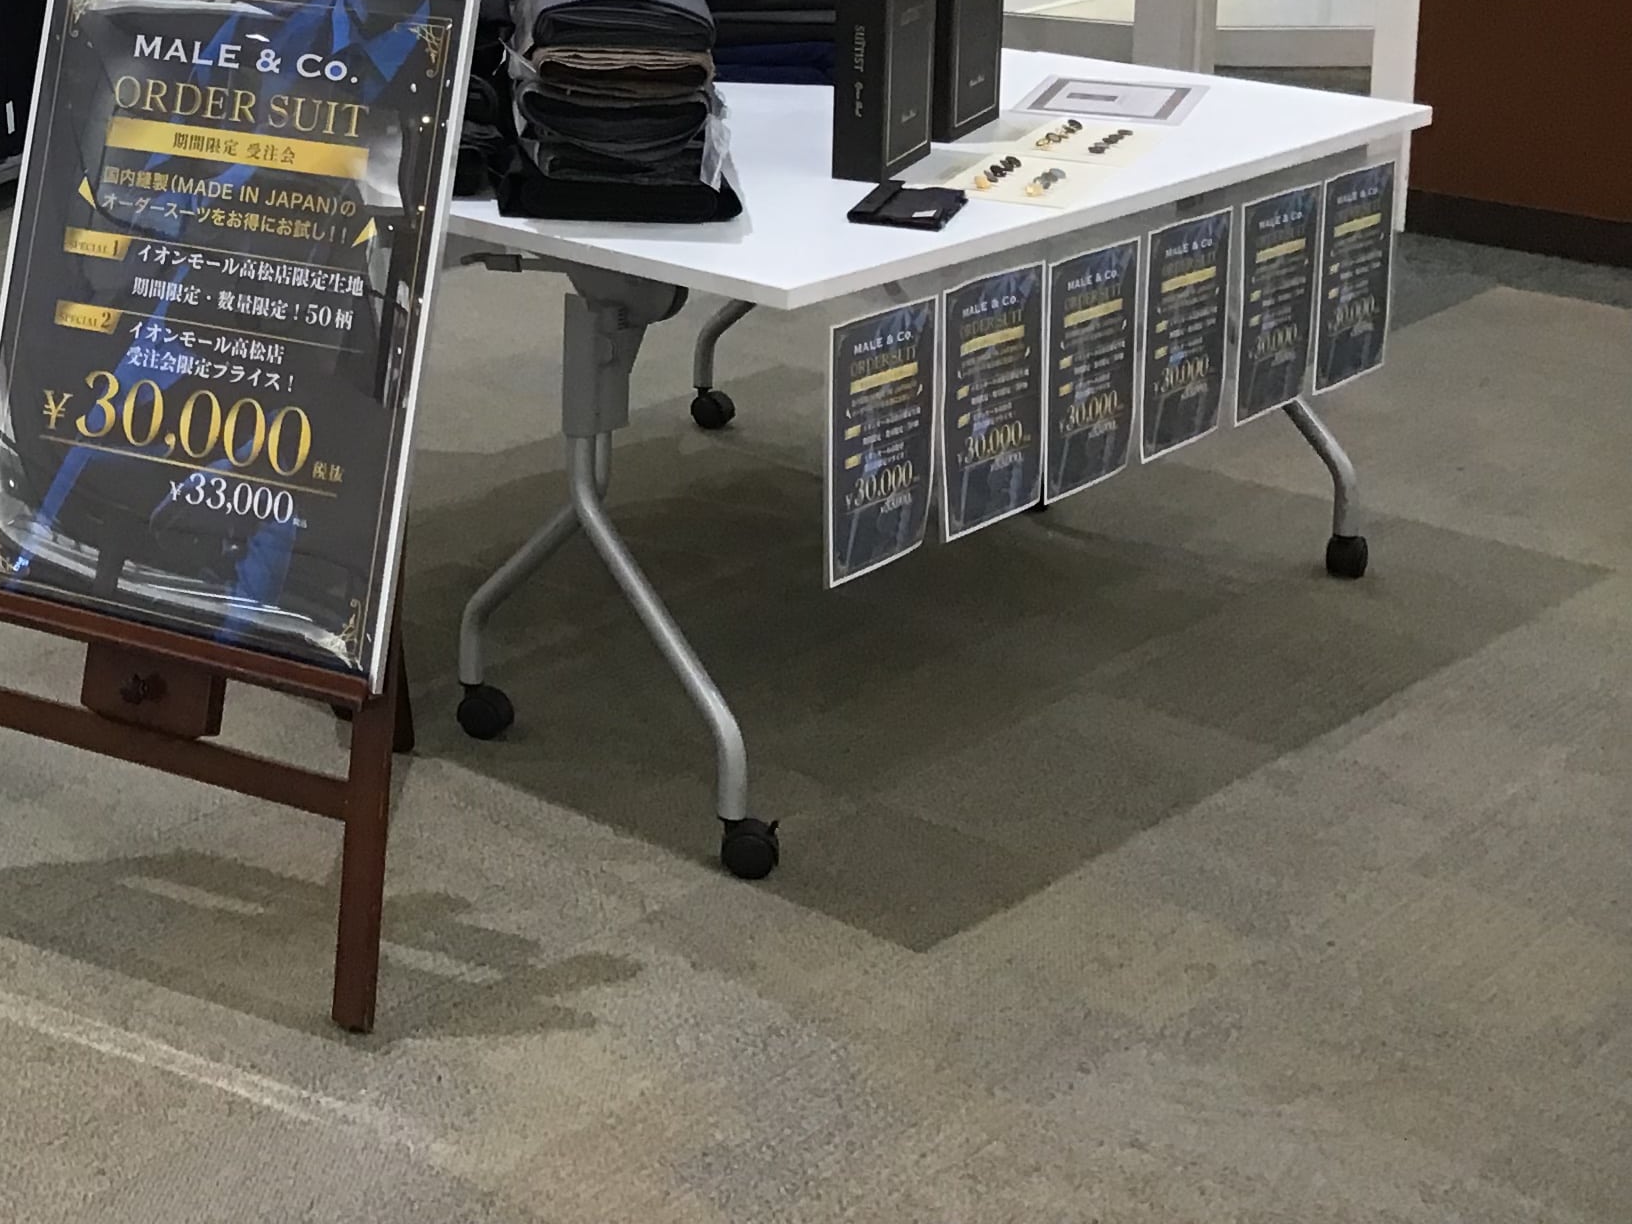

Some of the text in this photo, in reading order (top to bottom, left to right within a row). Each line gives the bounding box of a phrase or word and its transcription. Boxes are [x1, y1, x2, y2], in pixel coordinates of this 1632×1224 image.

[134, 34, 358, 84] MALE & Co.
[115, 75, 370, 138] ORDER SUIT
[173, 131, 297, 165] 期間限定 受注会
[240, 188, 260, 204] IN
[137, 242, 366, 297] イオンモール高松店限定生地
[100, 311, 112, 329] 2
[129, 320, 287, 365] イオンモール高松店
[126, 345, 296, 392] 受注会限定プライス!
[853, 336, 883, 355] MALE
[168, 472, 294, 524] ¥33,000
